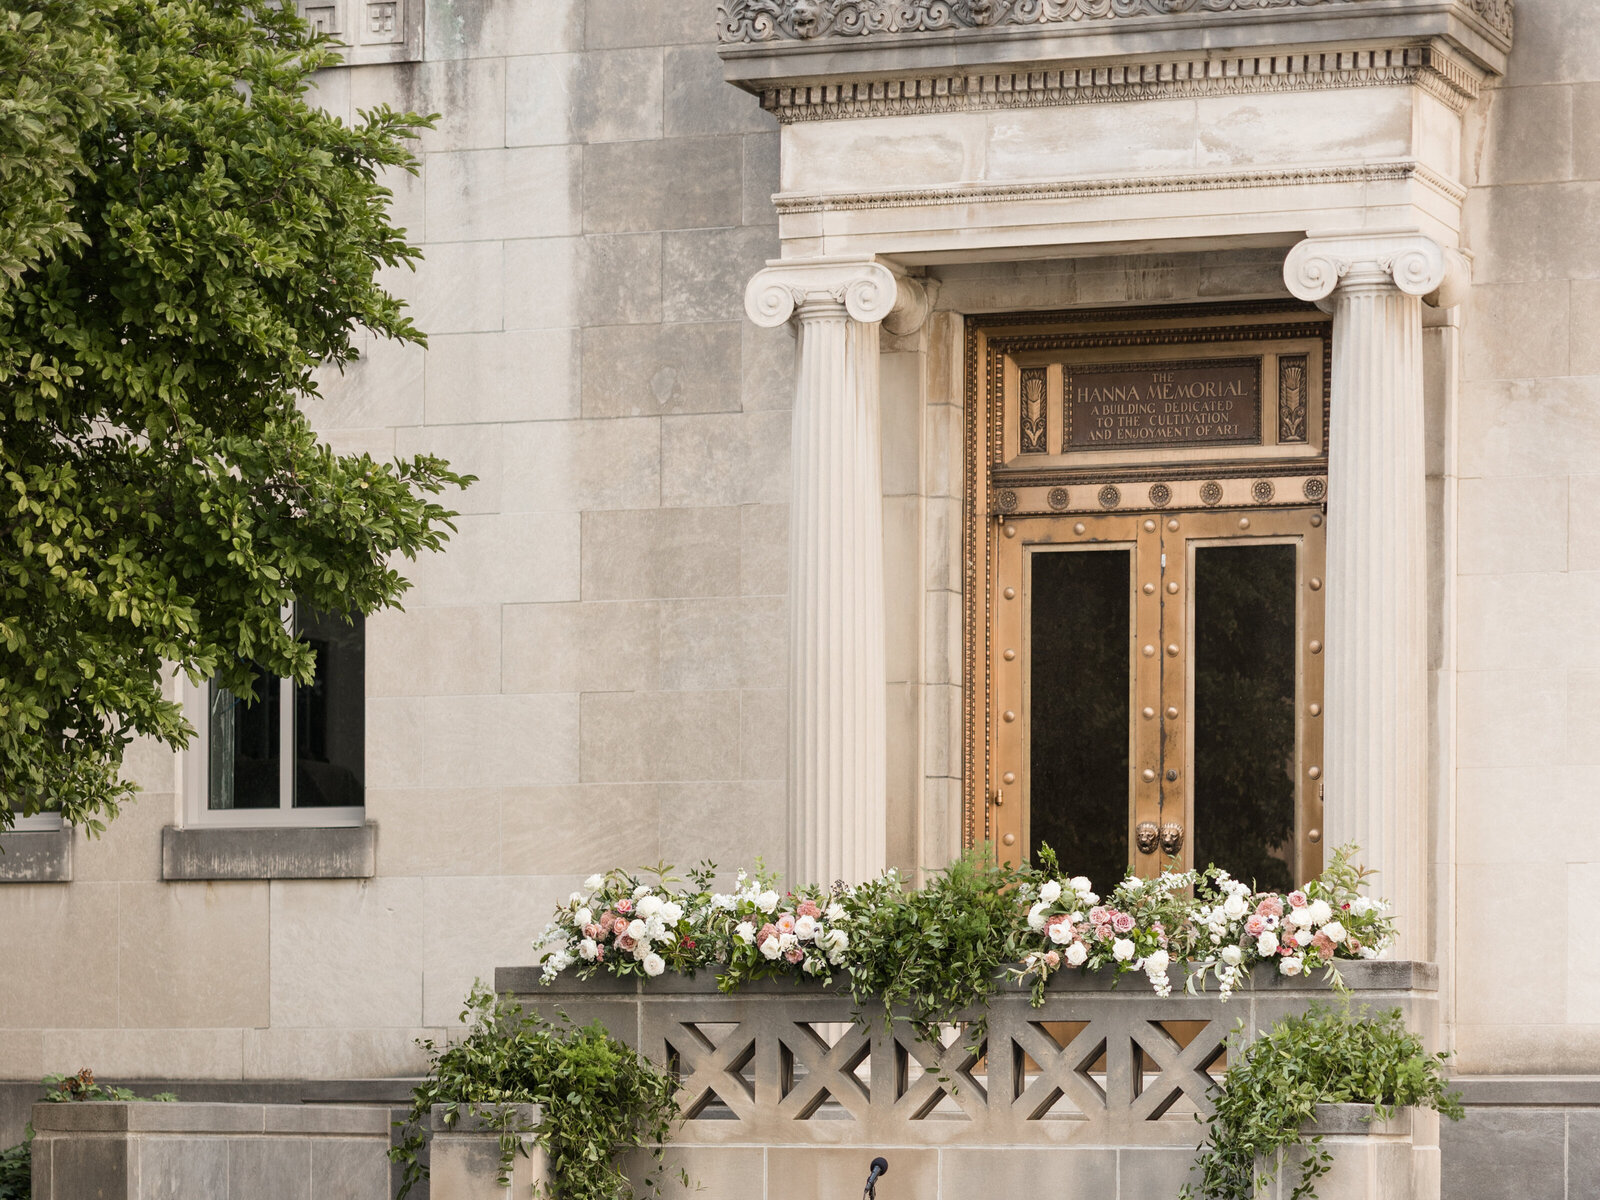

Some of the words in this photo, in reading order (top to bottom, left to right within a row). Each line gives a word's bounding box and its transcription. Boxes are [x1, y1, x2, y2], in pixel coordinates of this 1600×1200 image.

[1152, 372, 1175, 383] THE
[1077, 385, 1140, 403] HANNA
[1146, 379, 1248, 400] MEMORIAL
[1091, 407, 1100, 416] A
[1102, 403, 1156, 416] BUILDING
[1164, 400, 1233, 413] DEDICATED
[1097, 416, 1113, 428] TO
[1118, 416, 1140, 427] THE
[1149, 412, 1229, 426] CULTIVATION
[1088, 430, 1112, 441] AND
[1117, 426, 1190, 440] ENJOYMENT
[1195, 425, 1213, 437] OF
[1215, 424, 1240, 435] ART
